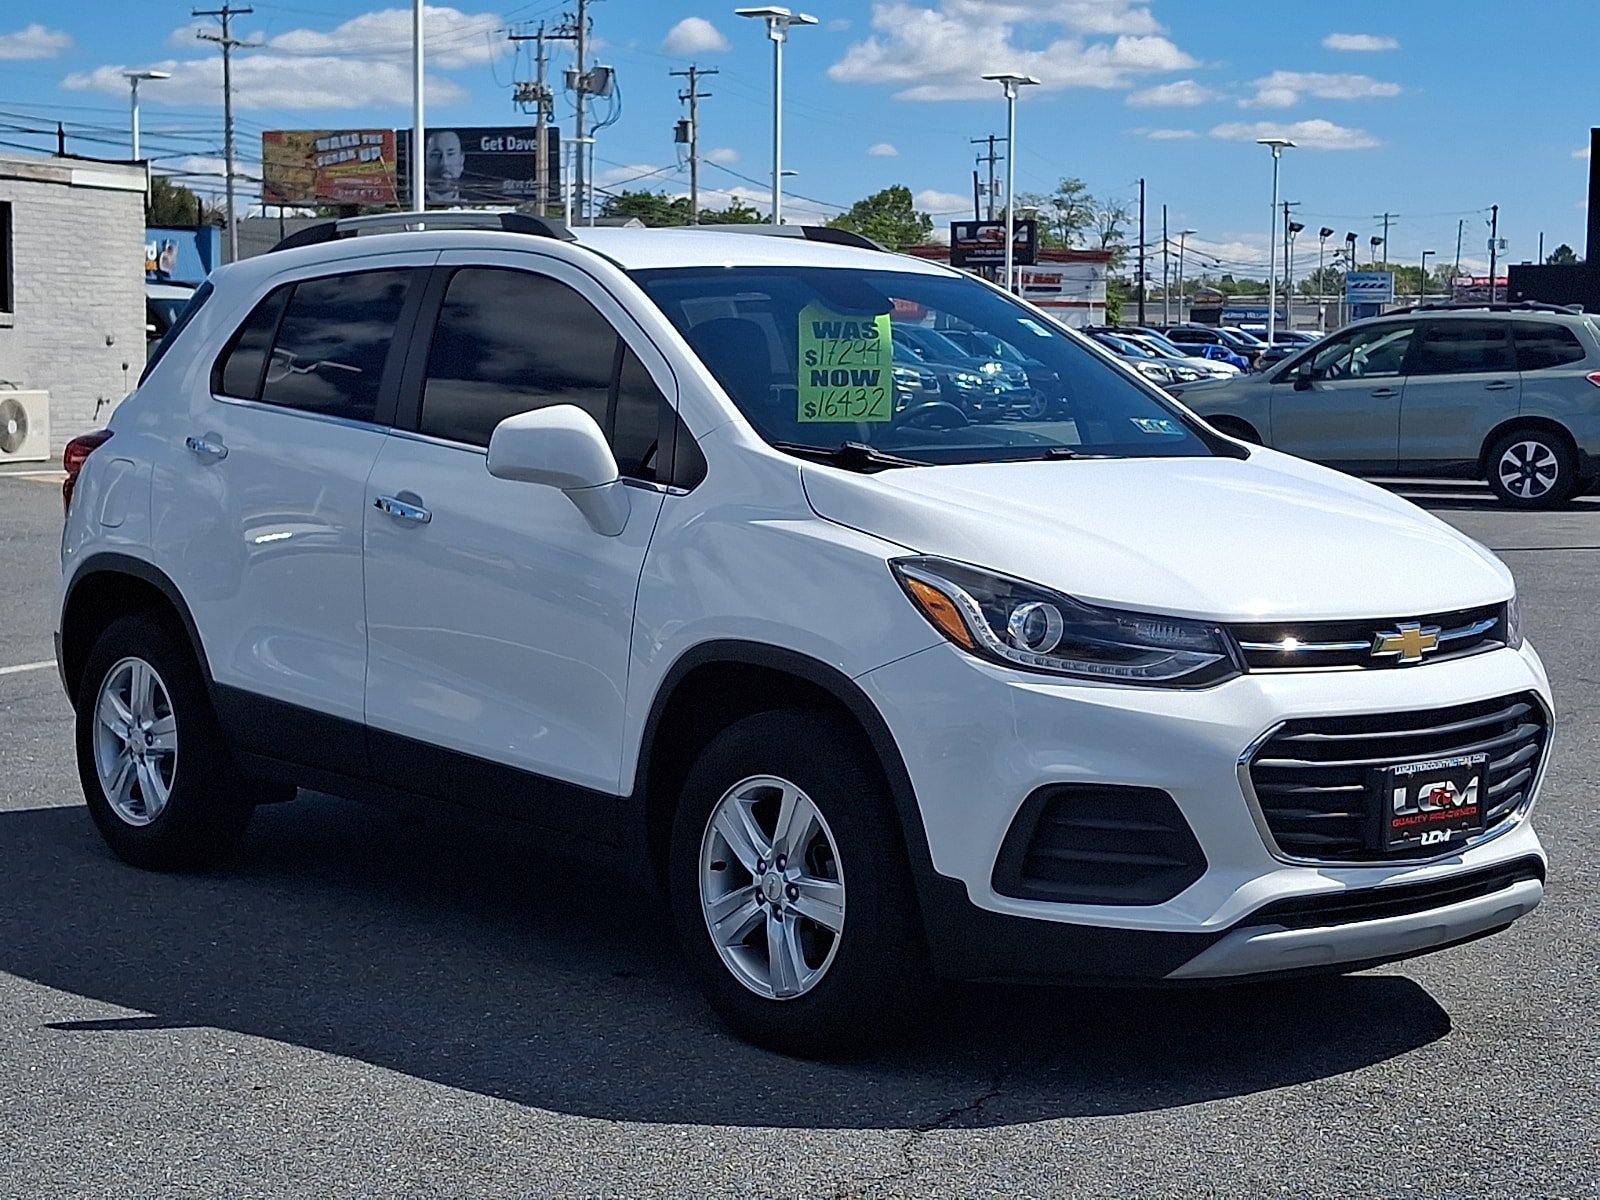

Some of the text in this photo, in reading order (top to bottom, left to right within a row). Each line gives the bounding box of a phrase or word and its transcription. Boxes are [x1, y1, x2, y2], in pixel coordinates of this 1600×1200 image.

[481, 136, 538, 151] Get Dave
[812, 321, 880, 339] WAS
[805, 340, 882, 367] $17294
[810, 369, 881, 387] NOW
[804, 388, 885, 419] $16432
[1394, 776, 1479, 815] LCM
[1392, 813, 1428, 828] QUALITY
